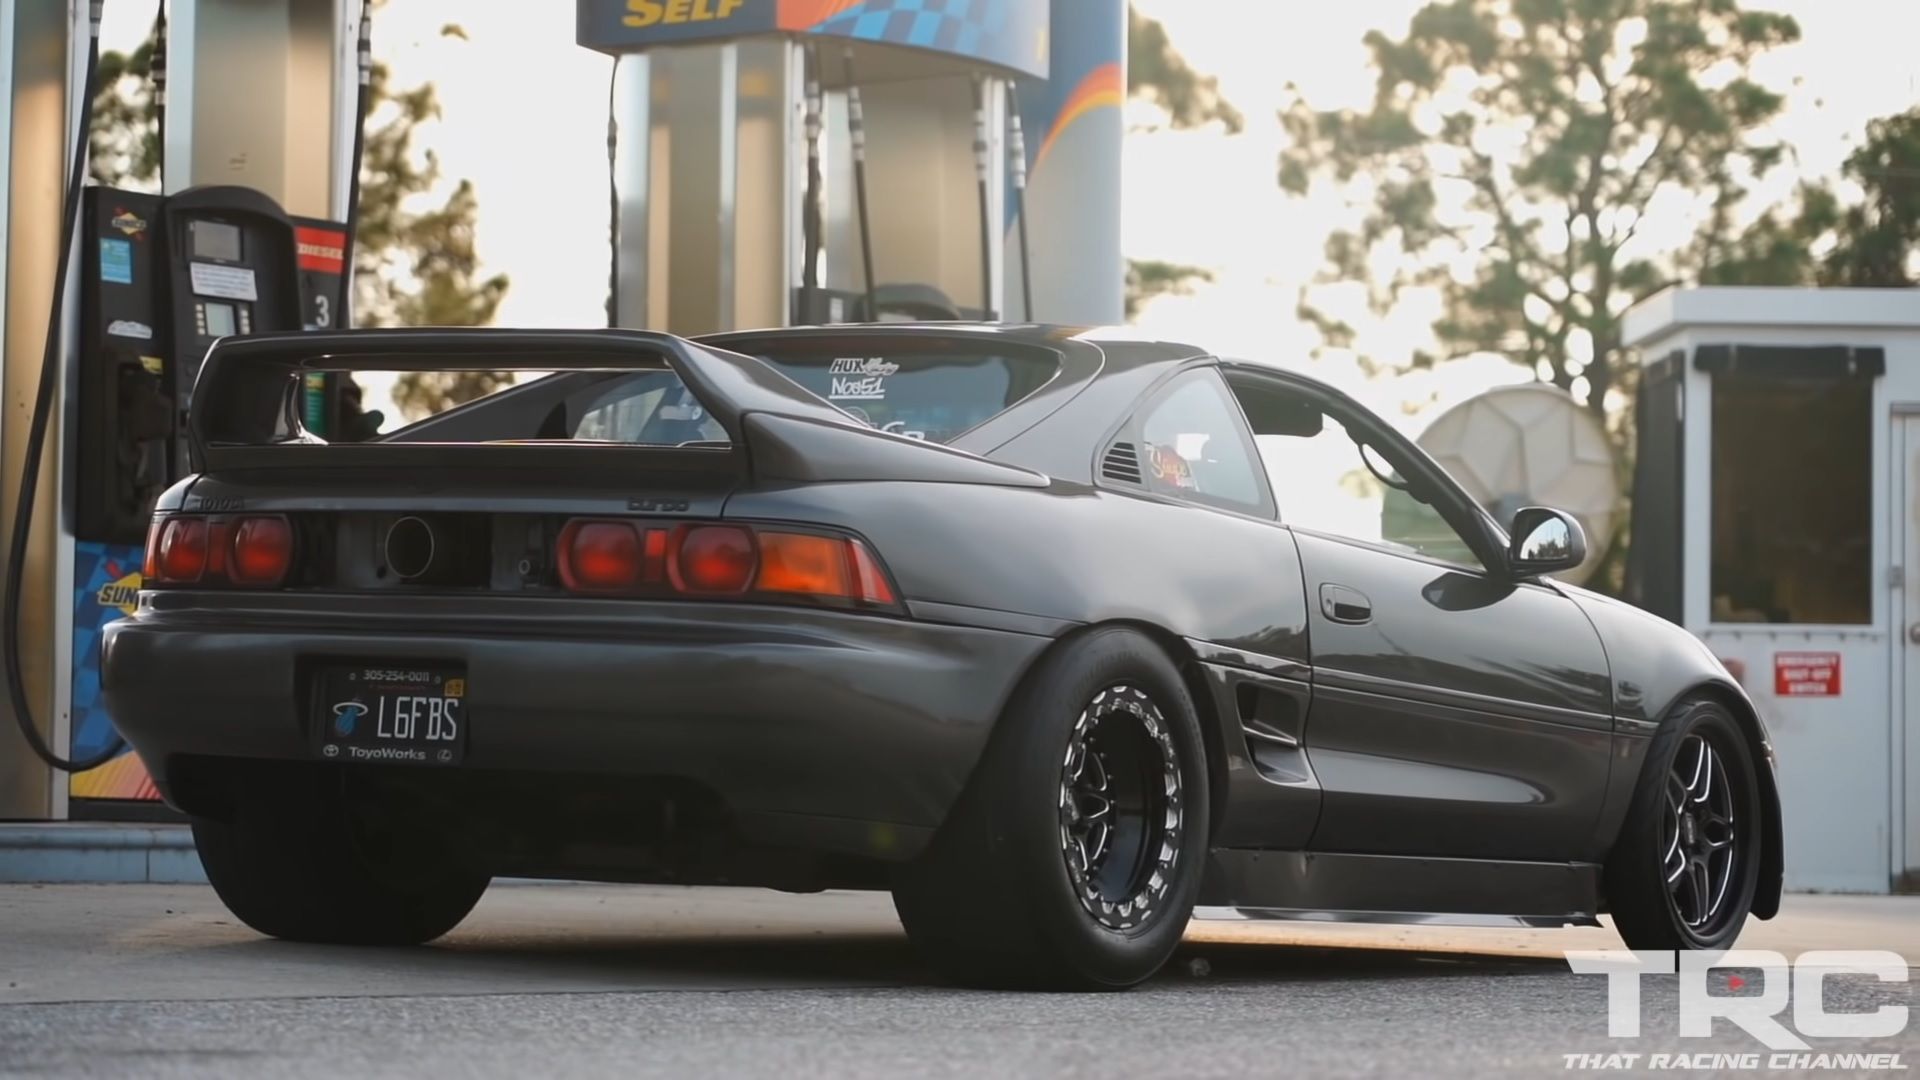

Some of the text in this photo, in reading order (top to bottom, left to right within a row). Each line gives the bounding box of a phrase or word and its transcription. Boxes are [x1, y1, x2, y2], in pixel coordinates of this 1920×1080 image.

[623, 0, 744, 27] SELF
[297, 242, 344, 260] DIESEL
[315, 295, 330, 328] 3
[829, 358, 866, 374] HUX
[363, 670, 430, 682] 305-254-0011
[377, 695, 459, 740] L6FBS
[348, 746, 427, 760] ToyoWorks
